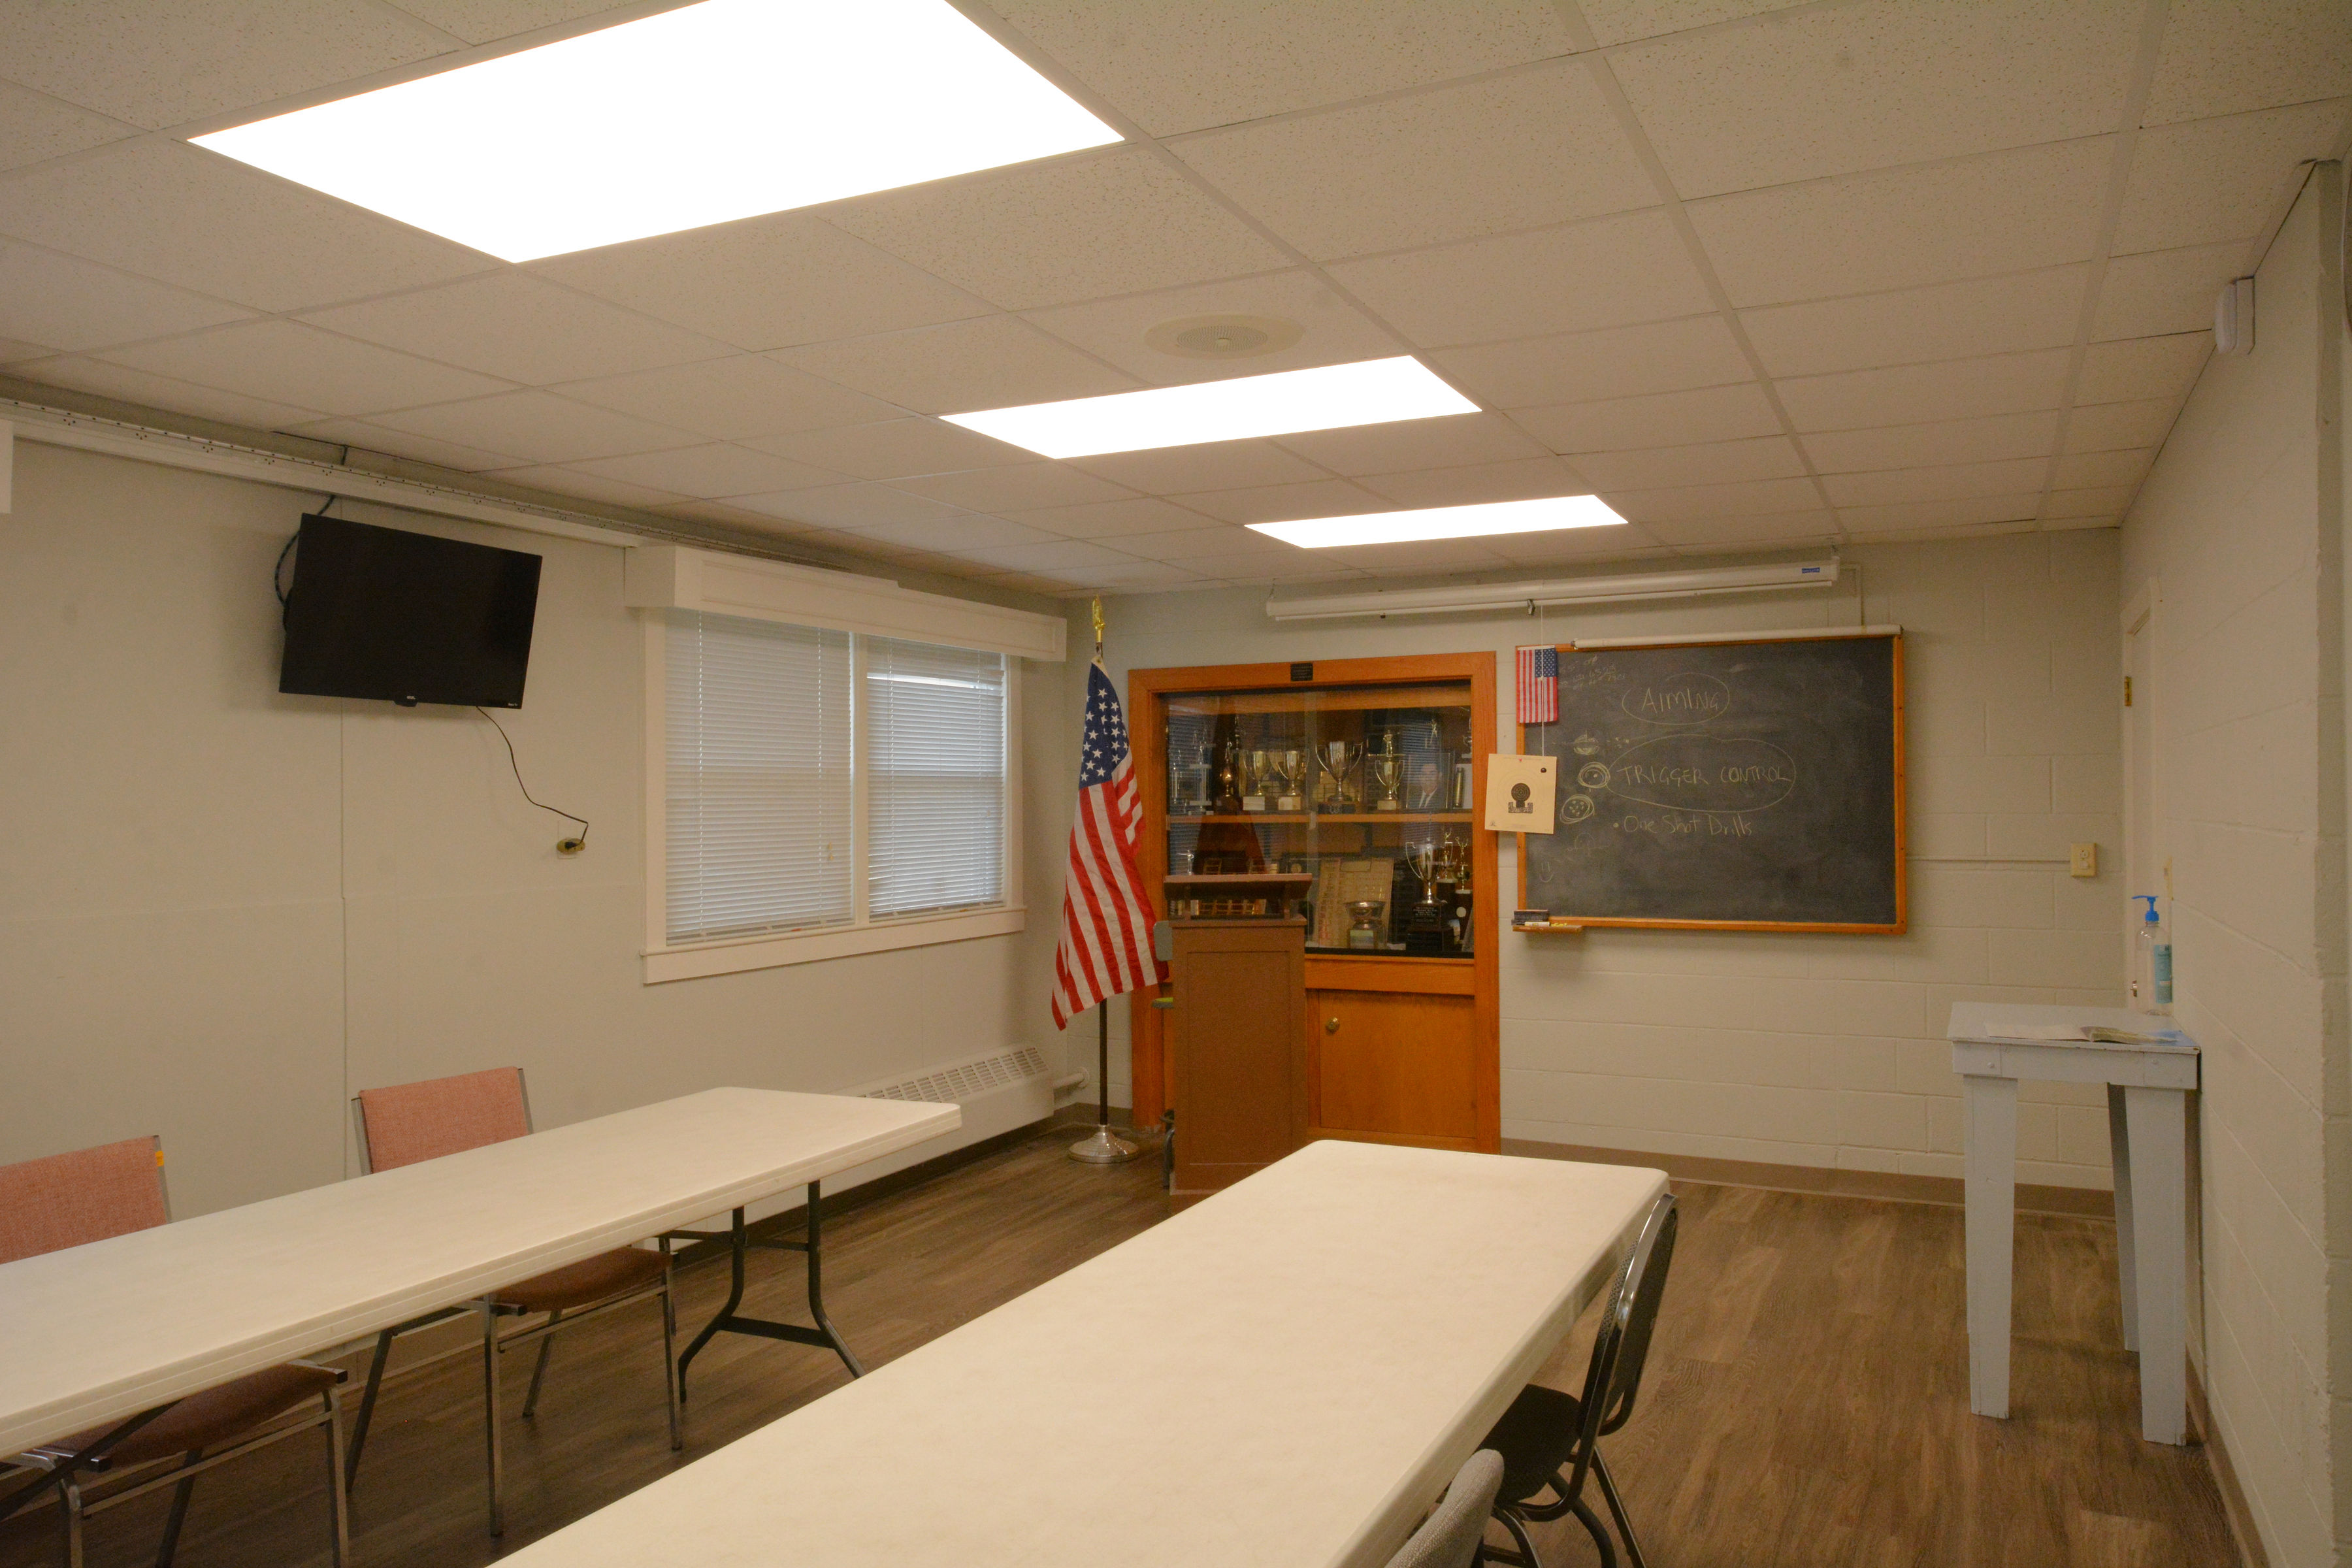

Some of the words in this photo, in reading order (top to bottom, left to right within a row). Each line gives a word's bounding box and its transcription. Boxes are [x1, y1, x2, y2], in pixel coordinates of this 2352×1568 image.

[1641, 687, 1720, 714] AIMING
[1616, 764, 1709, 787] TRIGGER
[1720, 764, 1792, 784] CONTROL
[1624, 815, 1658, 834] One
[1662, 815, 1700, 834] Shot
[1705, 813, 1752, 837] Drills
